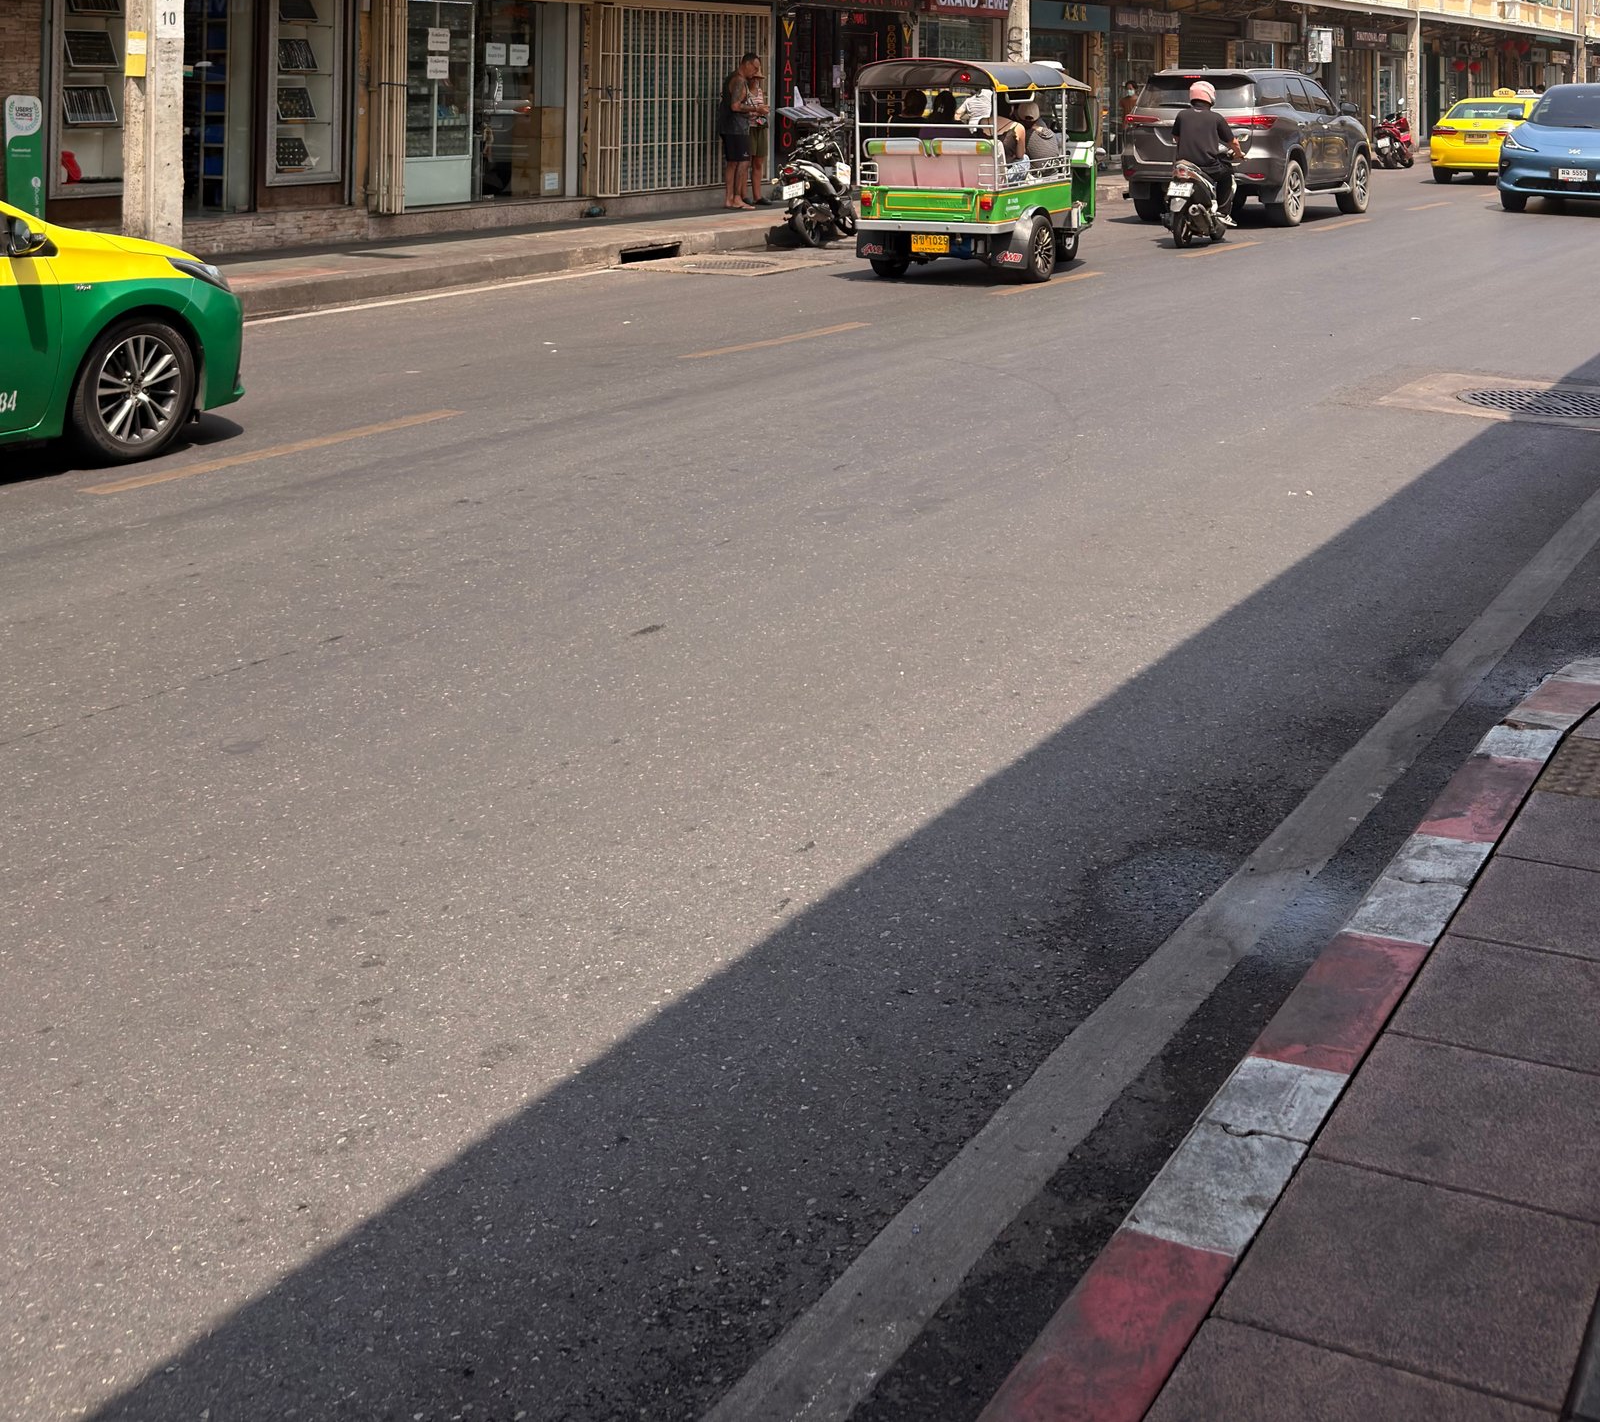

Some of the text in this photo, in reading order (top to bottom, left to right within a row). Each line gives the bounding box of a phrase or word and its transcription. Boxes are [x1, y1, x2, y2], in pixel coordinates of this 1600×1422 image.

[162, 11, 176, 25] 10
[928, 235, 949, 246] 1029
[996, 250, 1024, 264] 4WD
[0, 390, 18, 413] 84
